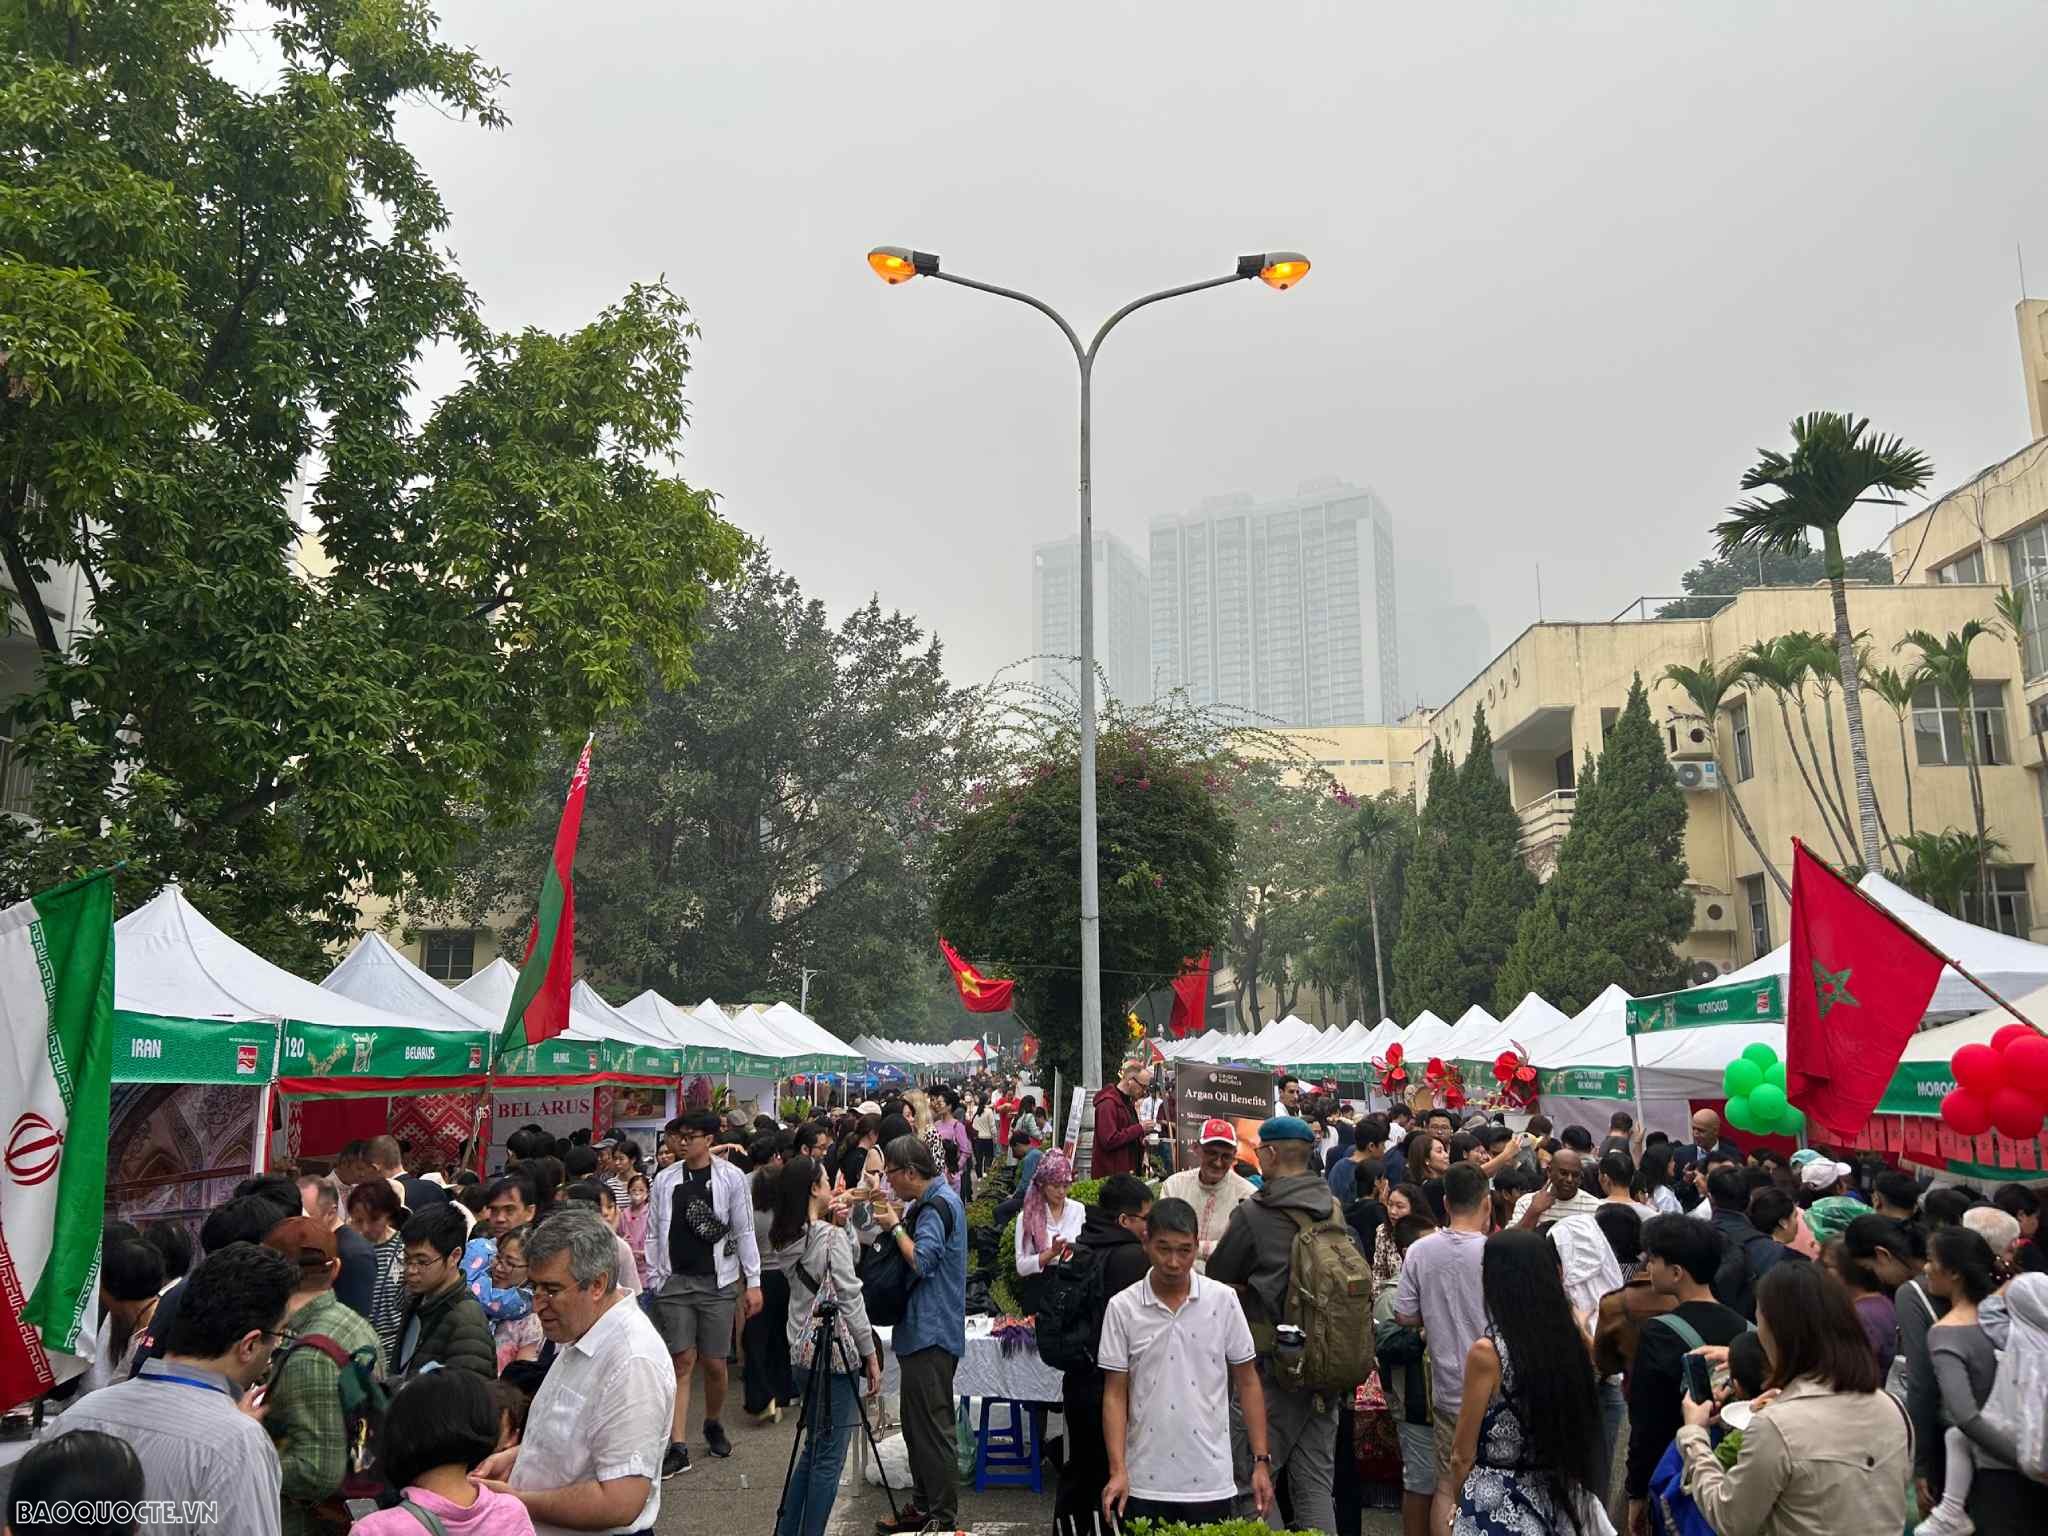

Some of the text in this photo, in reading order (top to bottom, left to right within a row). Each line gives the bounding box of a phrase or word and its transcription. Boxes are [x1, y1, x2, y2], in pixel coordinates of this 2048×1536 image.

[1697, 999, 1728, 1014] MOROCCO
[131, 1038, 162, 1058] IRAN
[285, 1037, 304, 1058] 120
[405, 1046, 436, 1060] BELARUS
[1185, 1088, 1267, 1106] Argan Oil Benefits
[498, 1098, 590, 1118] BELARUS
